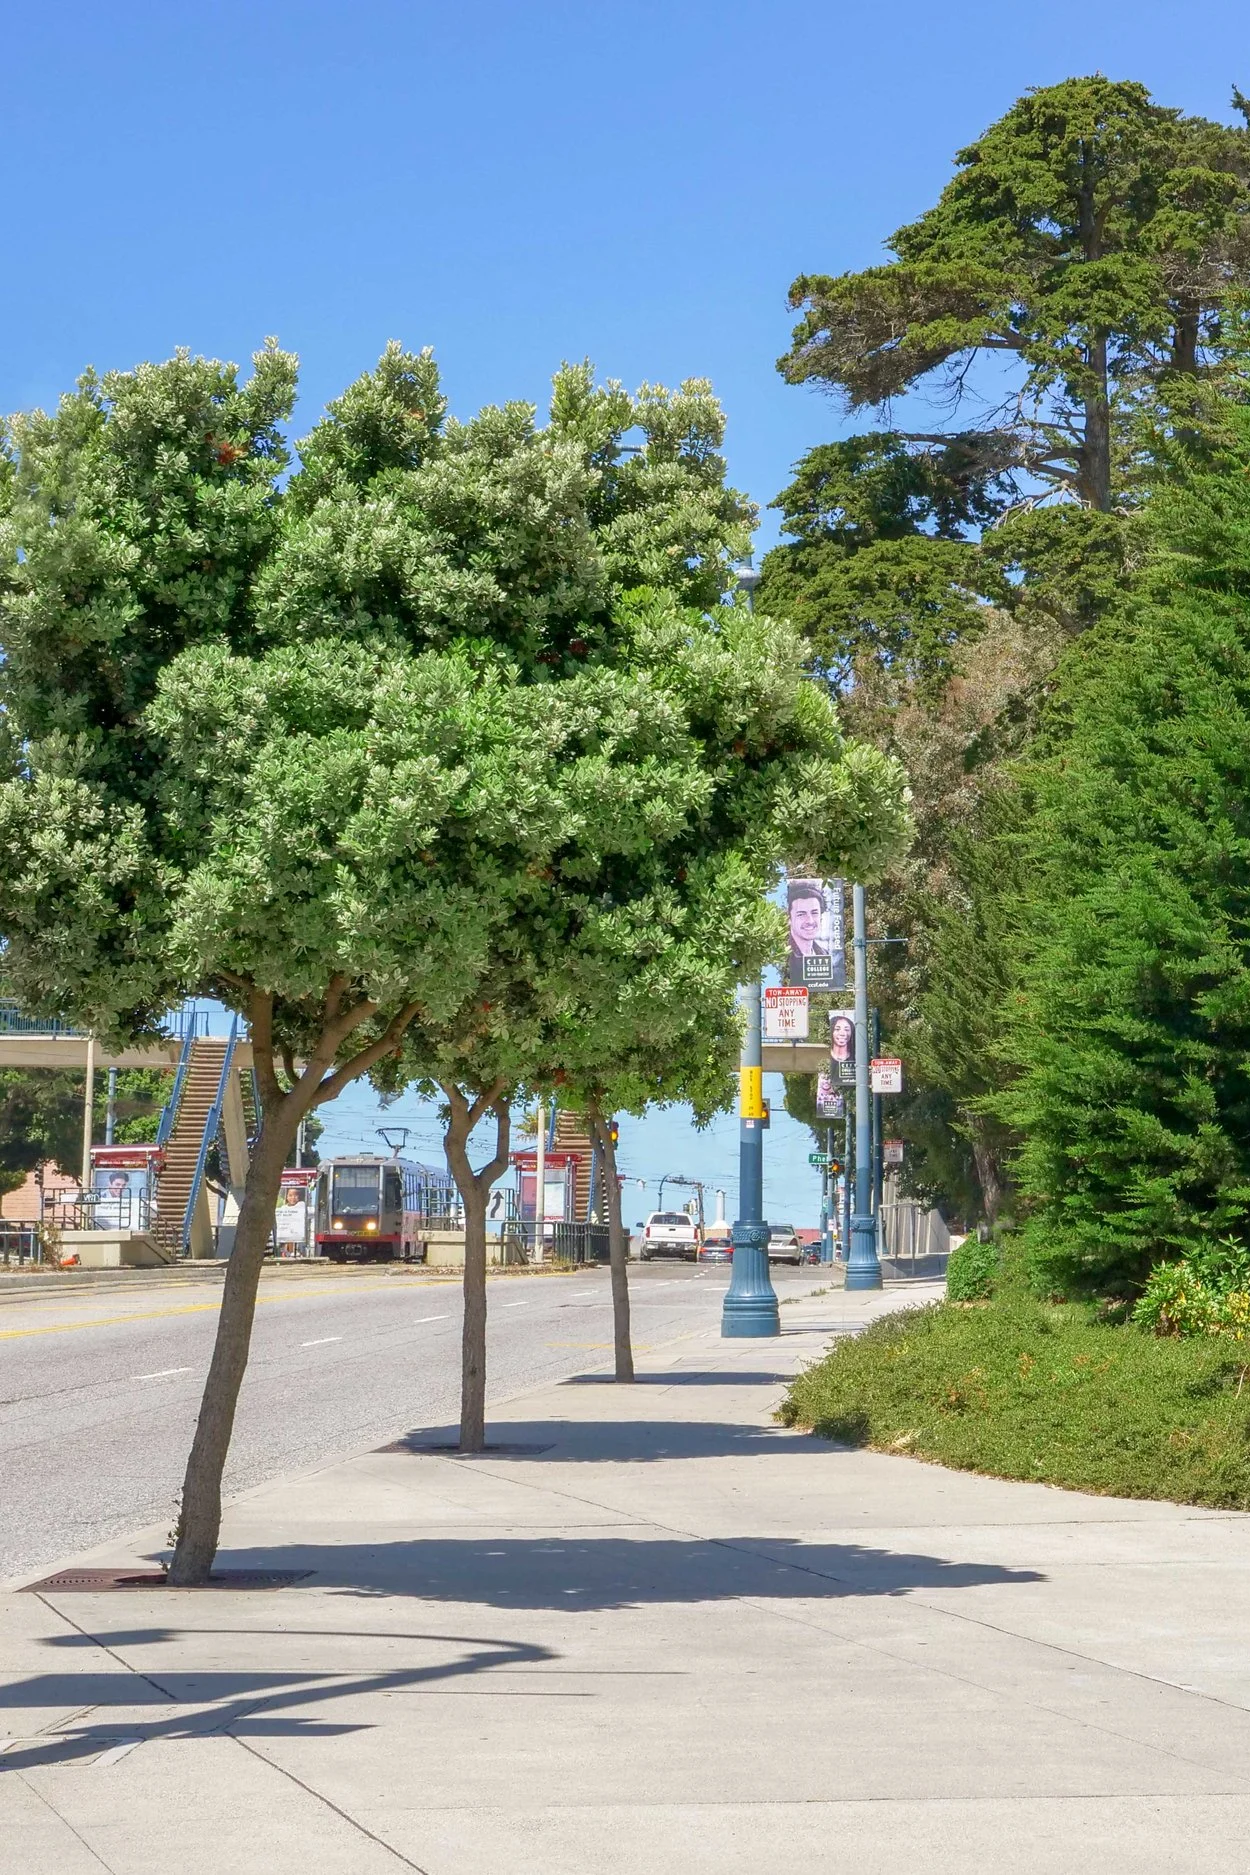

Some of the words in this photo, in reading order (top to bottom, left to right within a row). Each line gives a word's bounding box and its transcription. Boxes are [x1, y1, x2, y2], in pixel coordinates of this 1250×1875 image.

[833, 887, 842, 914] Future
[834, 916, 843, 950] Focused
[766, 997, 777, 1008] NO
[778, 997, 807, 1007] STOPPING
[778, 1009, 795, 1018] ANY
[777, 1019, 796, 1028] TIME
